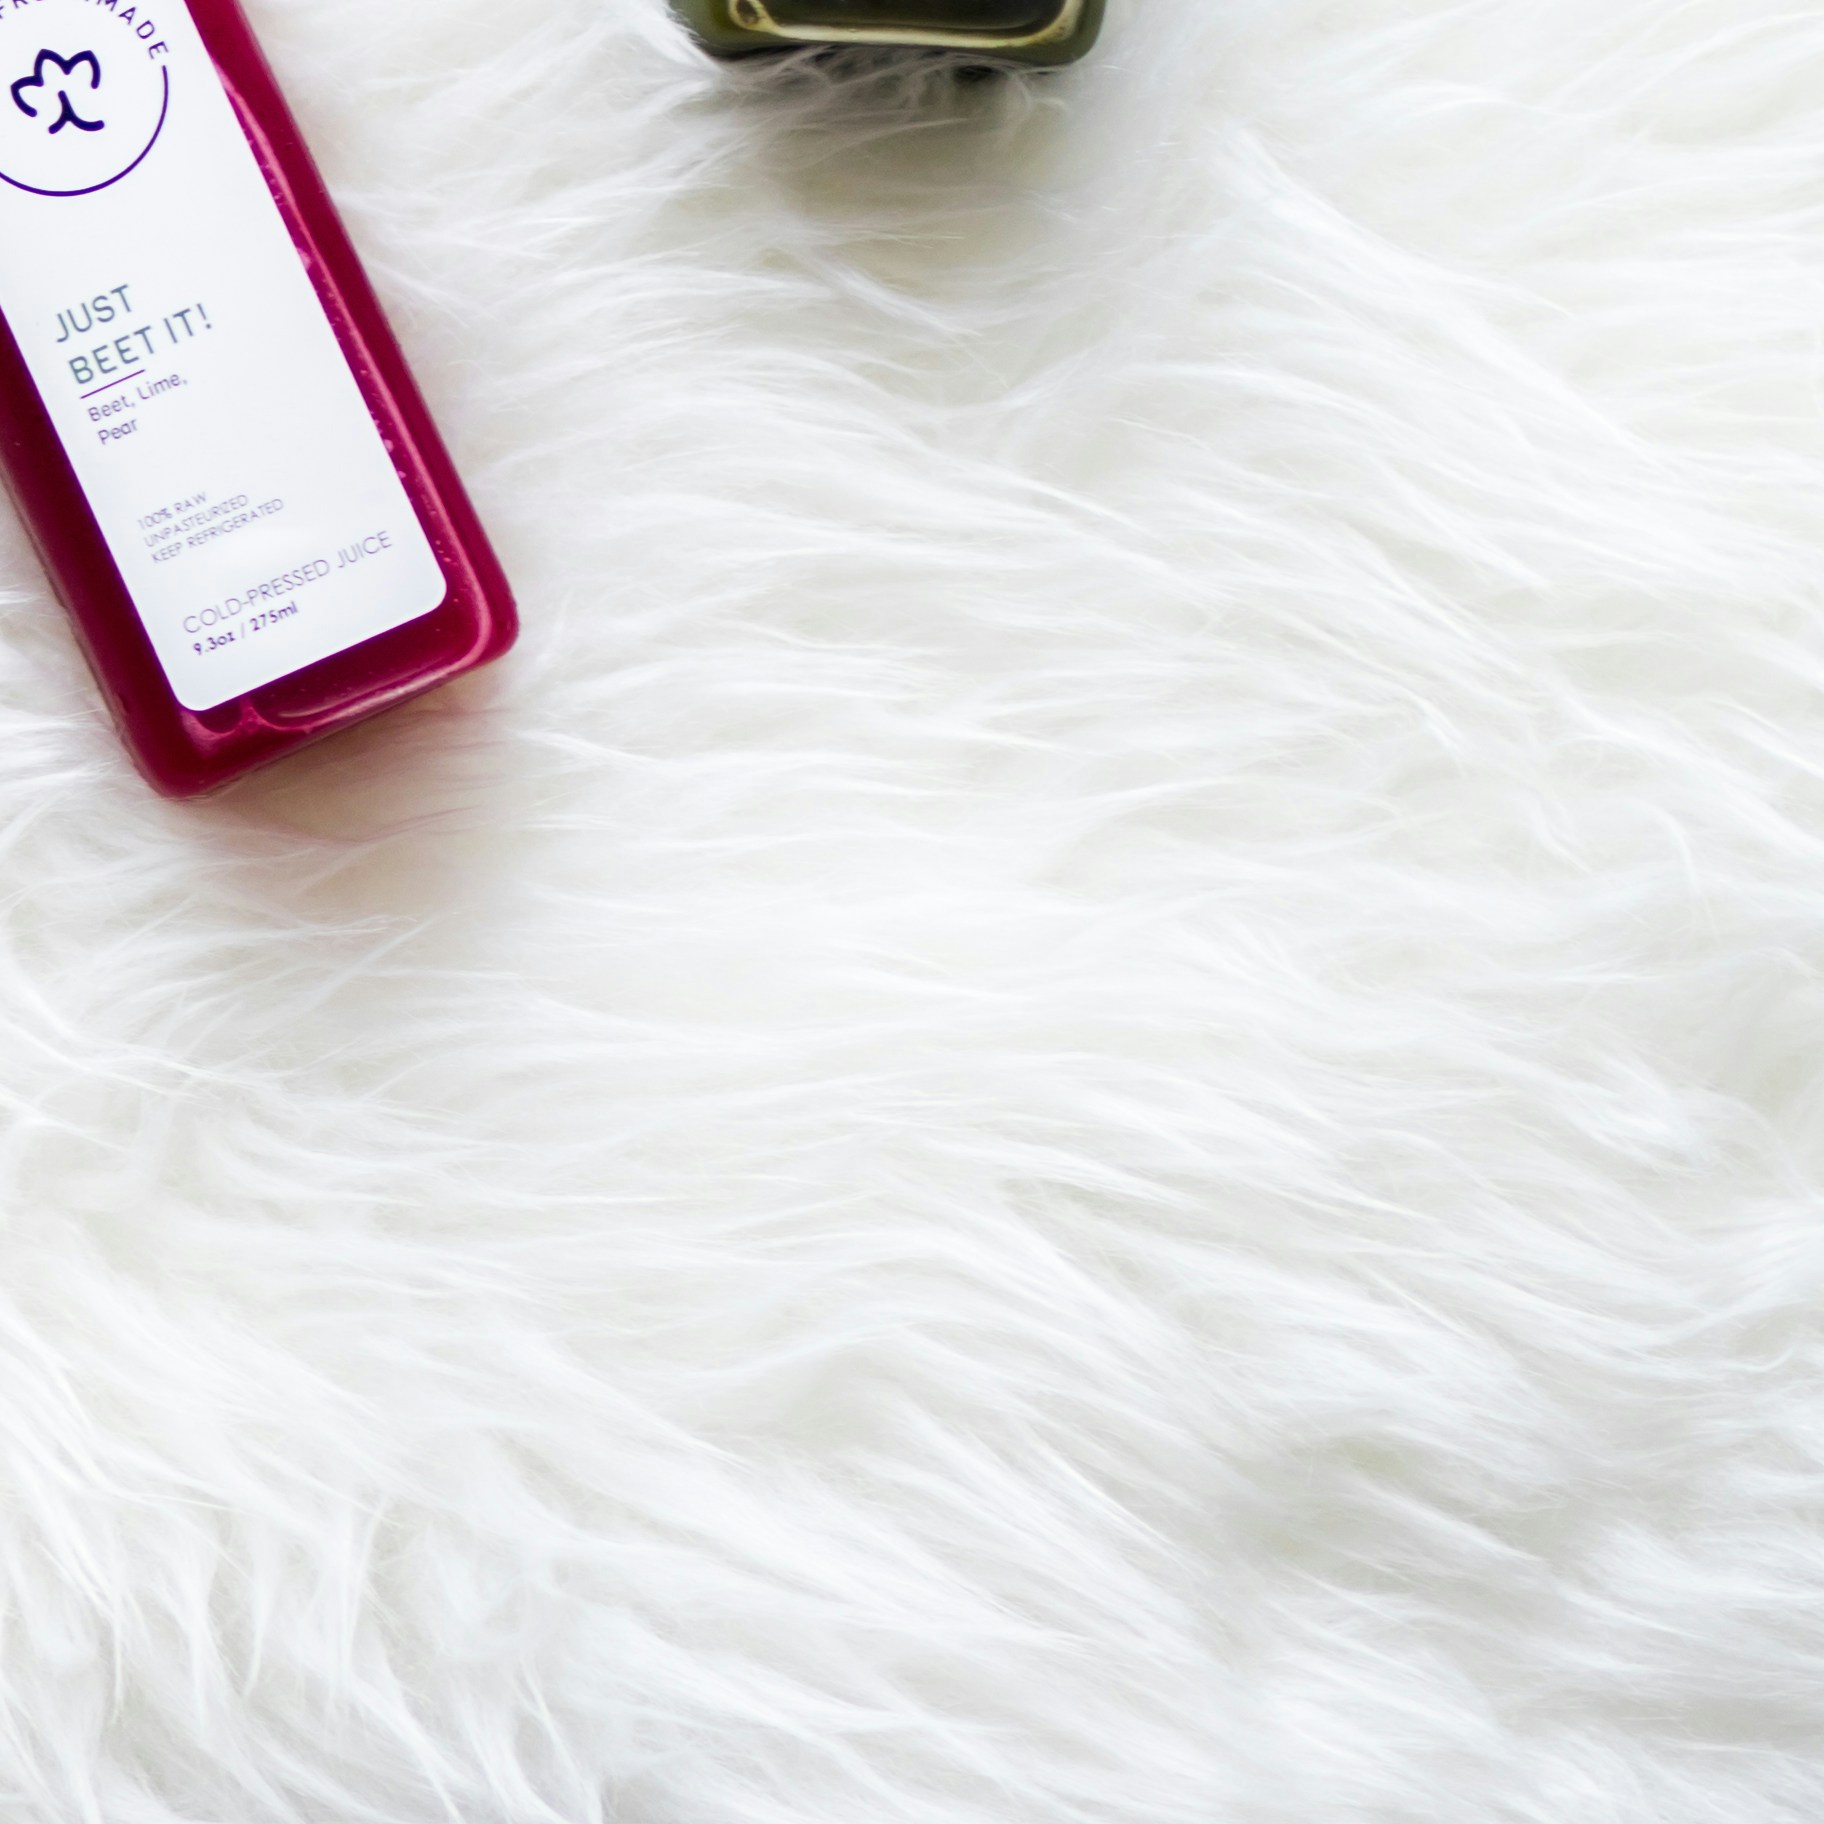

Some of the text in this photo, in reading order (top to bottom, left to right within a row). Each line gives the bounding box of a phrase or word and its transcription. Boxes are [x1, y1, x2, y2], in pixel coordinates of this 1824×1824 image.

[56, 284, 131, 343] JUST
[68, 303, 212, 384] BEET IT!
[87, 374, 187, 422] Beet, Lime,
[97, 419, 137, 445] Pear
[138, 492, 206, 529] 100% RAW
[144, 495, 248, 547] UNPASTEURIZED
[151, 499, 284, 563] KEEP REFRIGERATED
[183, 530, 392, 633] COLD-PRESSED JUICE
[193, 632, 236, 655] 9.3oz
[250, 601, 298, 631] 275ml
